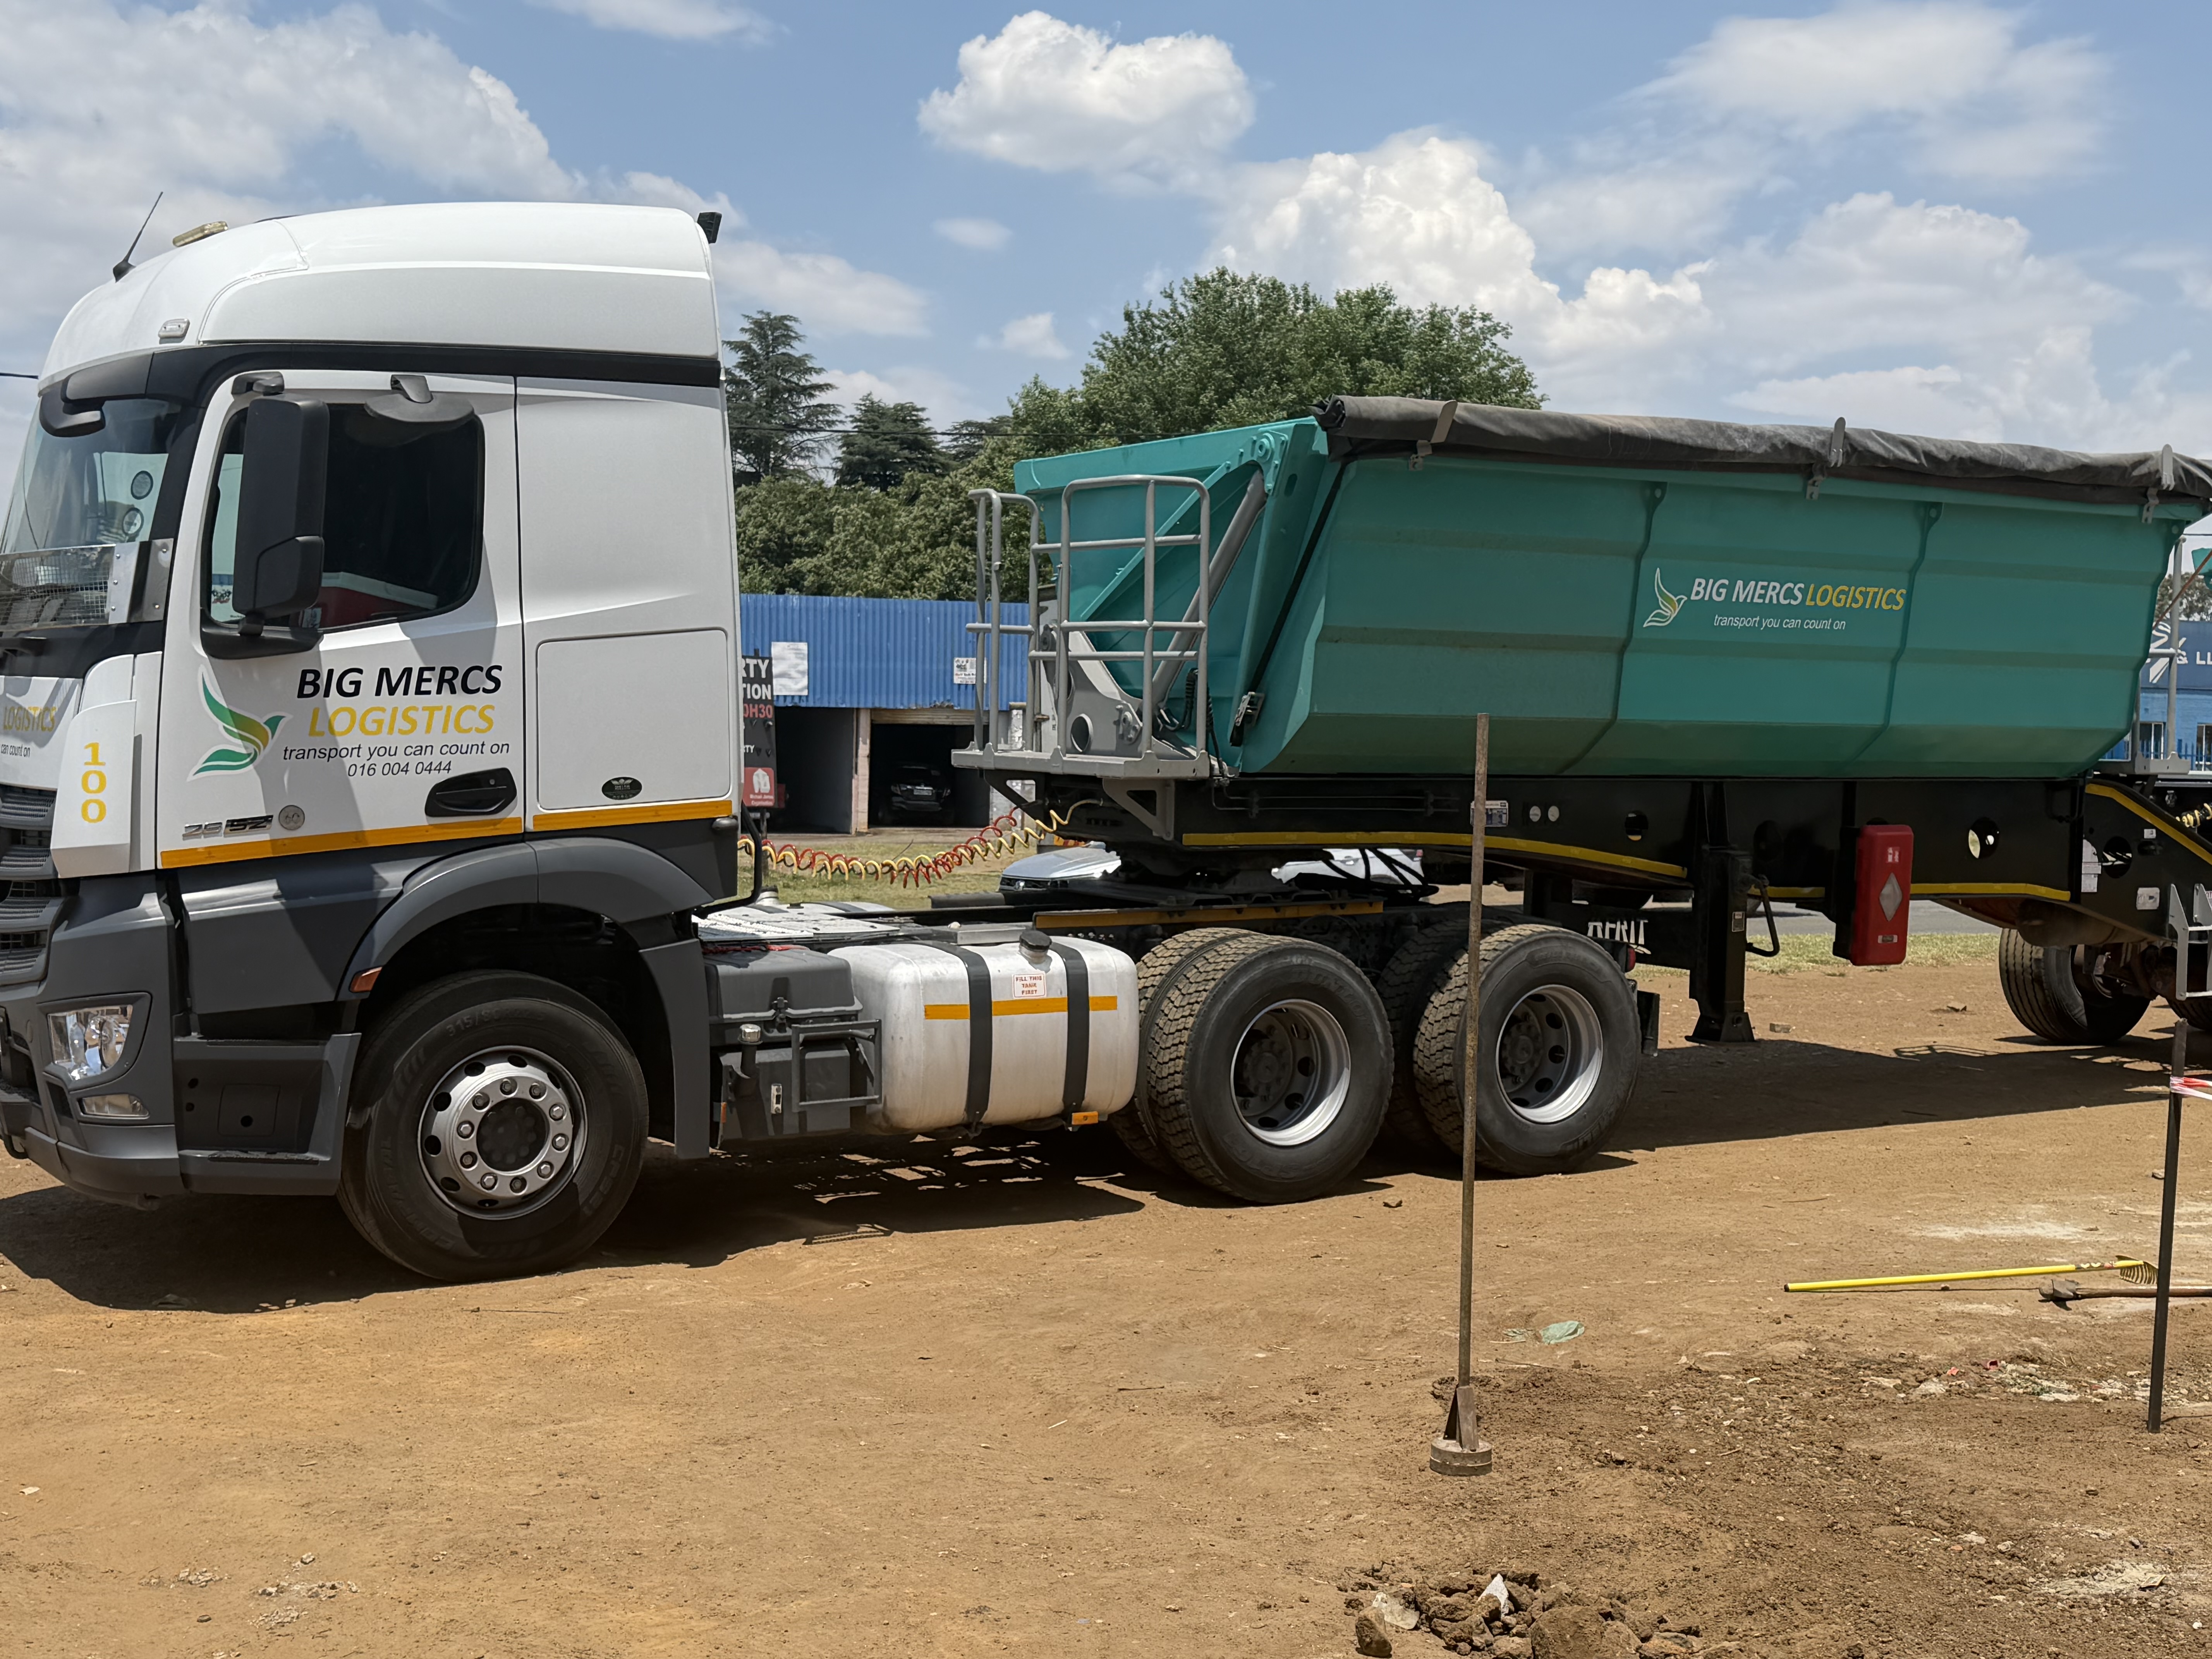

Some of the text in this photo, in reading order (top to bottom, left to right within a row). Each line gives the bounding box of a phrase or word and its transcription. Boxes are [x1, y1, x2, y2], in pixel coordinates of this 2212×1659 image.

[1690, 578, 1907, 611] BIG MERCS LOGISTICS
[1714, 614, 1846, 630] transport you can count on
[297, 665, 503, 699] BIG MERCS
[3, 706, 57, 732] LOGISTICS
[309, 704, 495, 737] LOGISTICS
[9, 744, 23, 756] count
[24, 747, 31, 758] on
[283, 741, 510, 763] transport you can count on
[348, 761, 452, 776] 016 004 0444
[81, 742, 107, 823] 100
